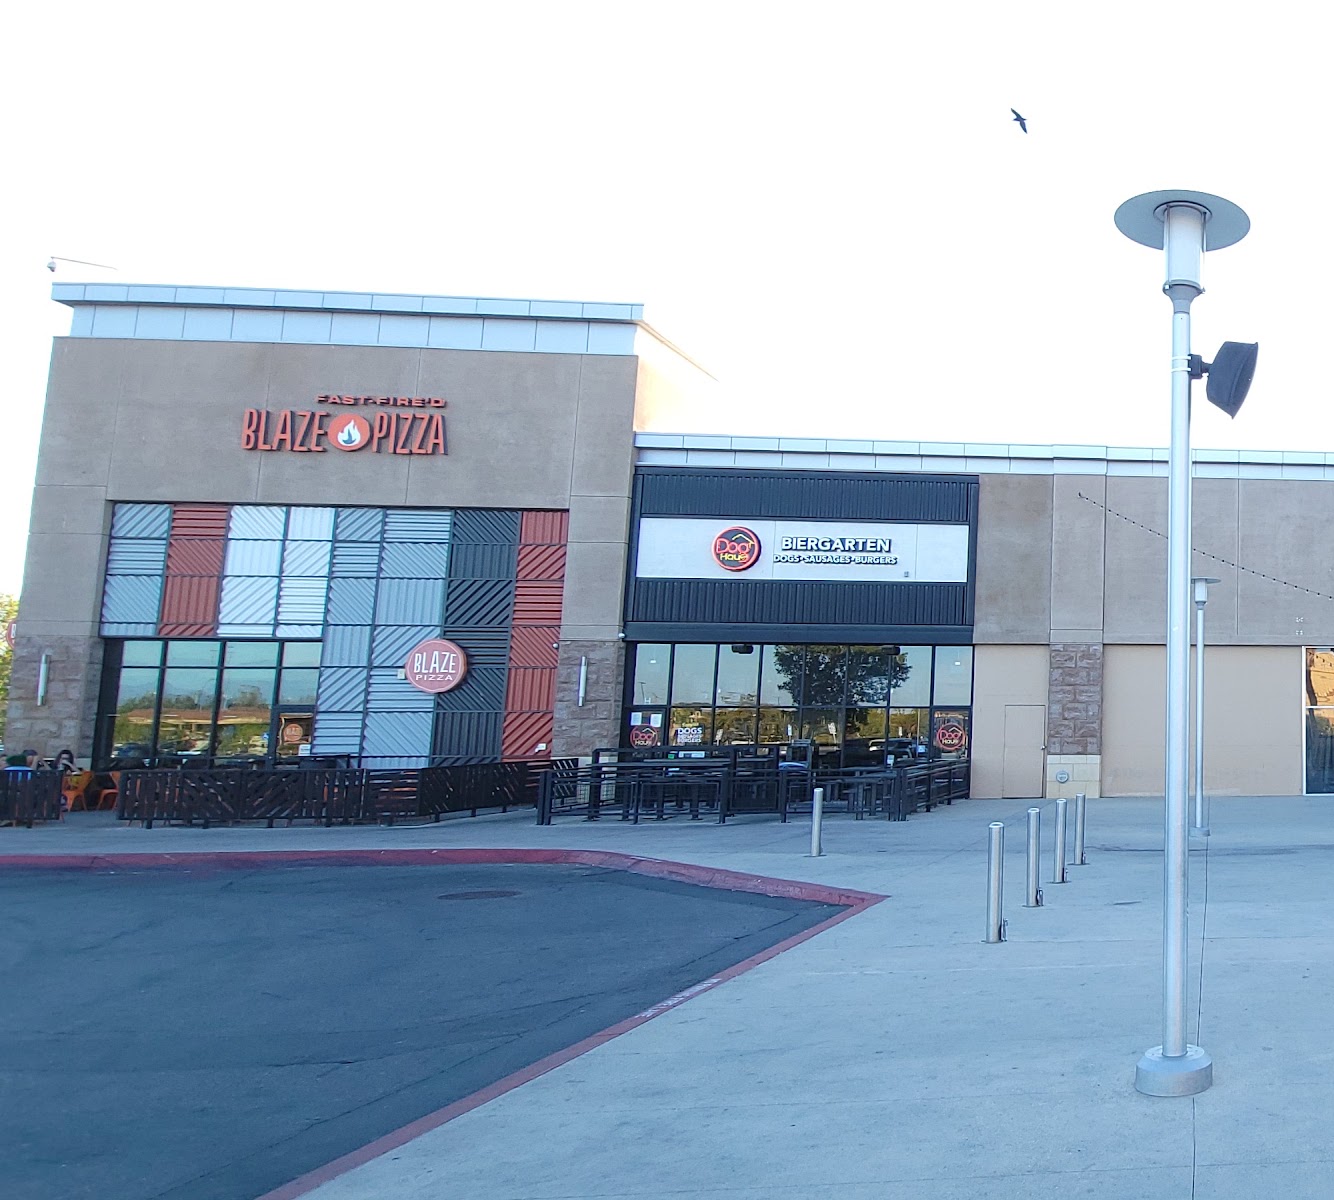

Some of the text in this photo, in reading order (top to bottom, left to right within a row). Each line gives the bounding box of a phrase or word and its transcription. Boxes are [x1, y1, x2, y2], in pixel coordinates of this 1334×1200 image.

[241, 408, 447, 455] BLAZE PIZZA
[716, 537, 751, 555] Dog
[781, 537, 891, 553] BIERGARTEN
[413, 651, 457, 673] BLAZE
